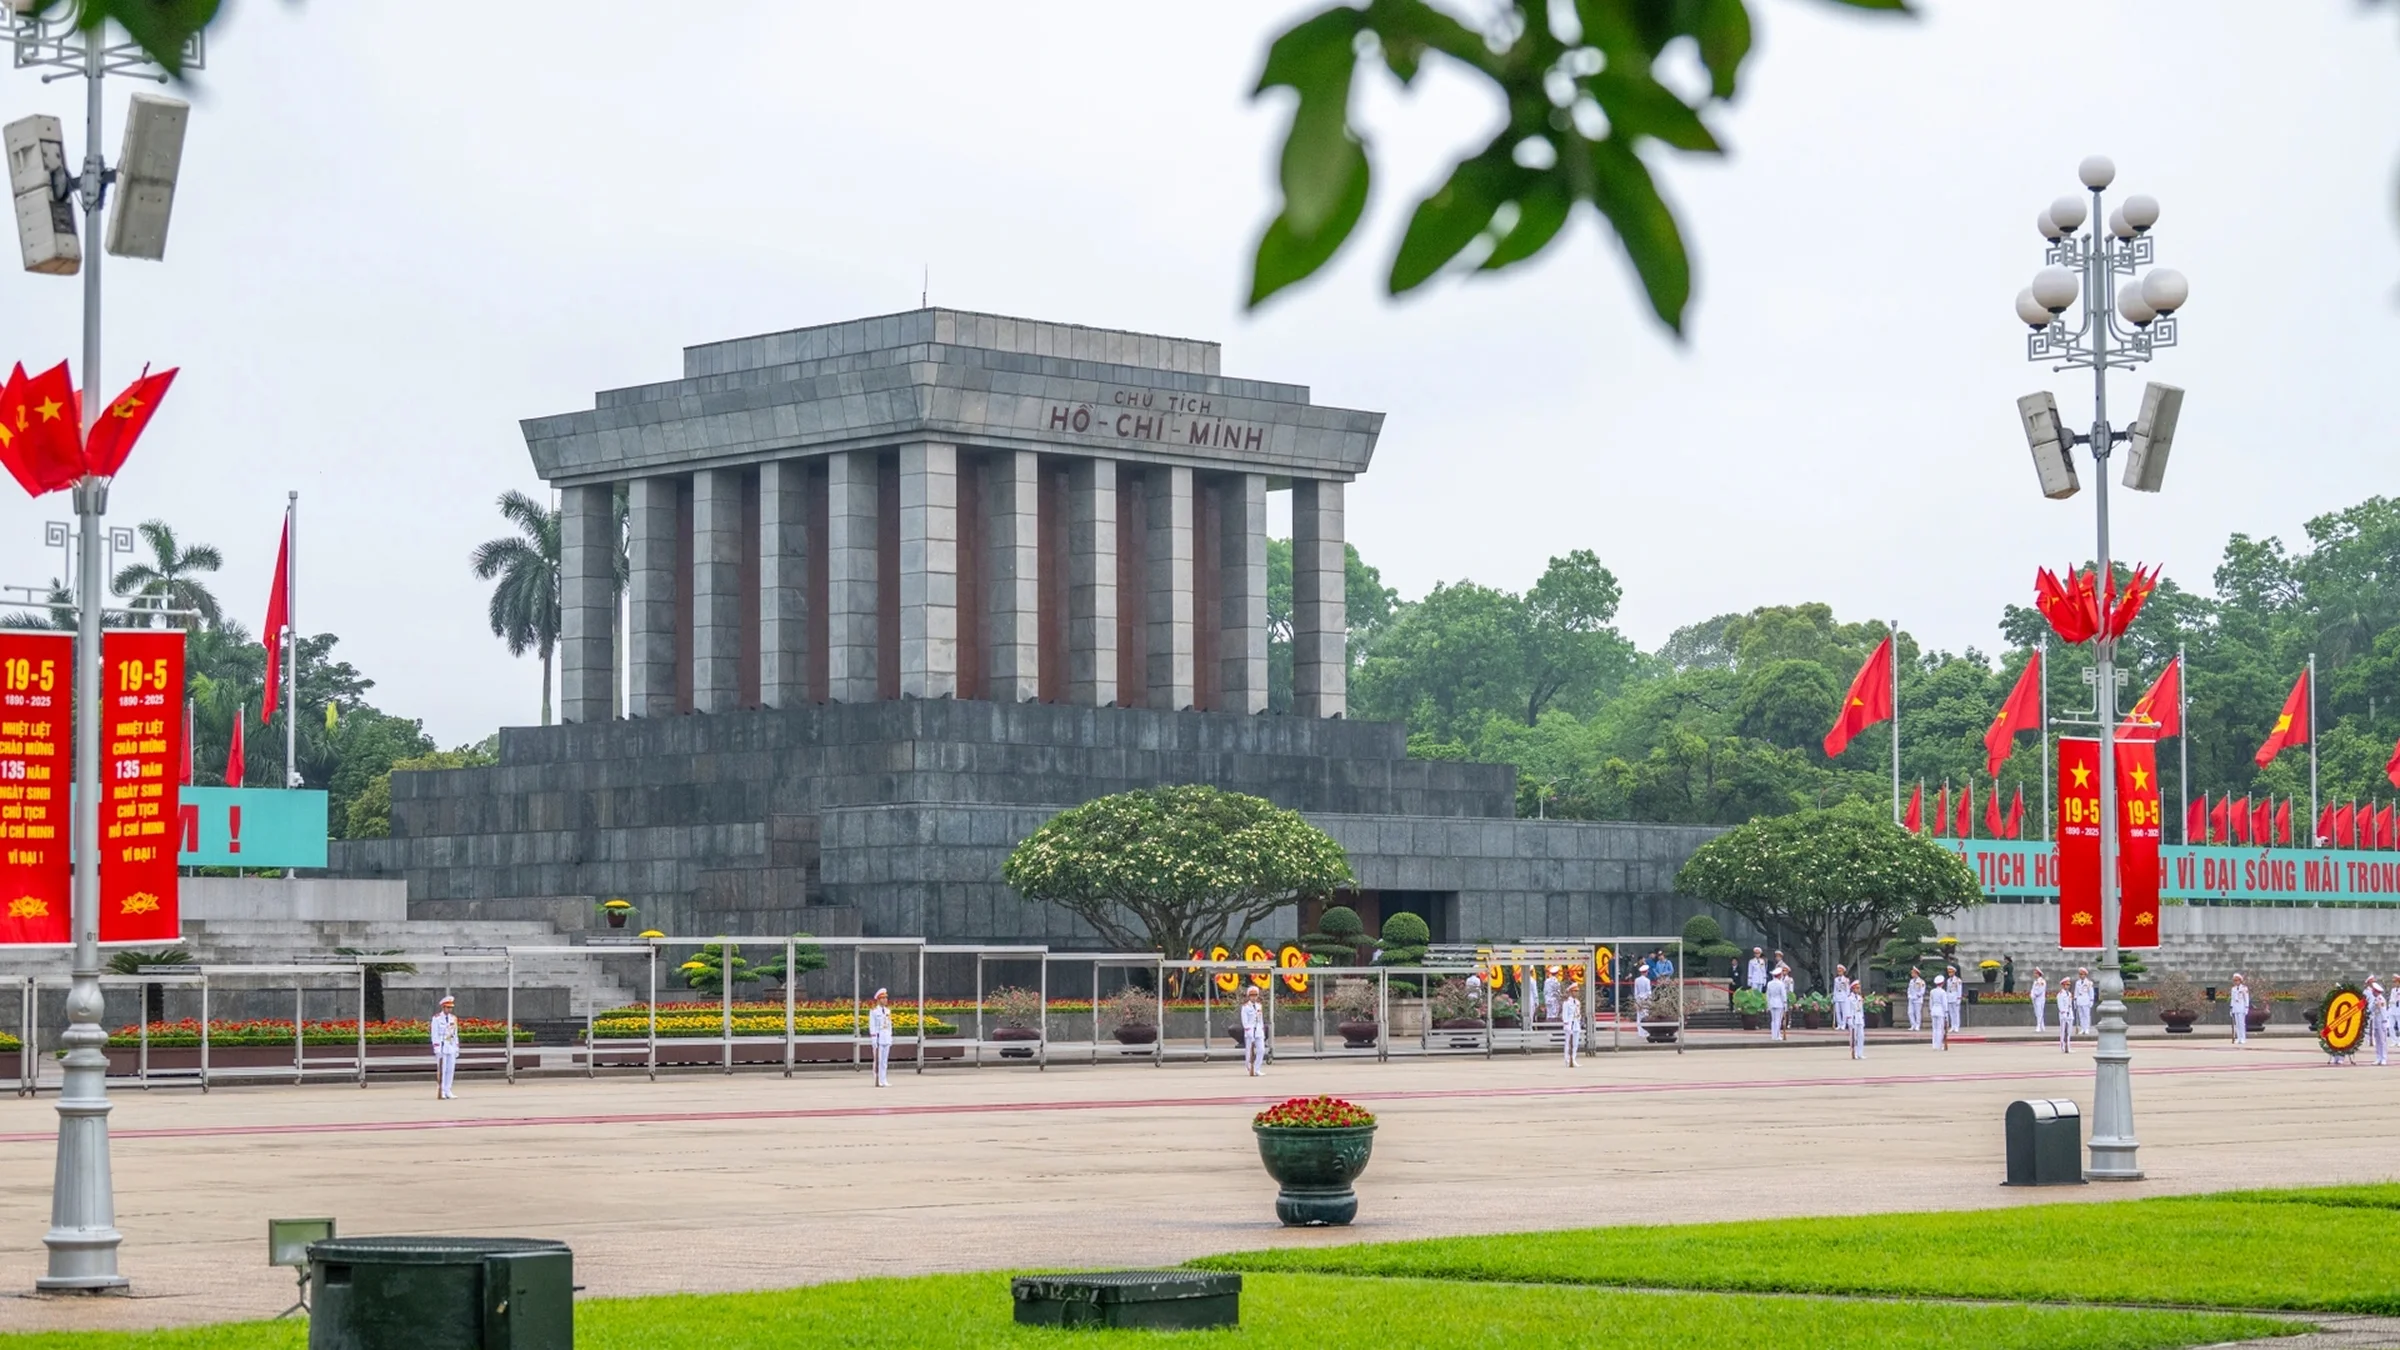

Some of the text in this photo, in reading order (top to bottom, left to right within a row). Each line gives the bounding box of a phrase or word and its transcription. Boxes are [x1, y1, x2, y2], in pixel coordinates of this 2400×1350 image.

[5, 658, 55, 692] 19-5
[118, 658, 168, 692] 19-5
[5, 694, 24, 706] 1890
[30, 695, 52, 707] 2025
[118, 695, 138, 707] 1890
[144, 694, 165, 706] 2025
[2, 720, 52, 740] NHIỆT LIỆT
[116, 719, 165, 738] NHIỆT LIỆT
[25, 740, 55, 756] MỪNG
[139, 737, 167, 754] MỪNG
[0, 760, 51, 780] 135 NĂM
[115, 759, 164, 779] 135 NĂM
[26, 787, 51, 800] SINH
[113, 783, 163, 800] NGÀY SINH
[2, 802, 46, 823] CHỦ TỊCH
[116, 800, 159, 820] CHỦ TỊCH
[2064, 797, 2100, 824] 19-5
[2127, 799, 2159, 826] 19-5
[27, 826, 55, 839] MINH
[141, 821, 165, 836] MINH
[2065, 826, 2081, 836] 1890
[2085, 827, 2100, 837] 2025
[1977, 852, 2025, 893] TỊCH
[2177, 852, 2196, 890] VĨ
[2203, 858, 2237, 897] ĐẠI
[2245, 849, 2297, 892] SỐNG
[2304, 856, 2340, 893] MÃI
